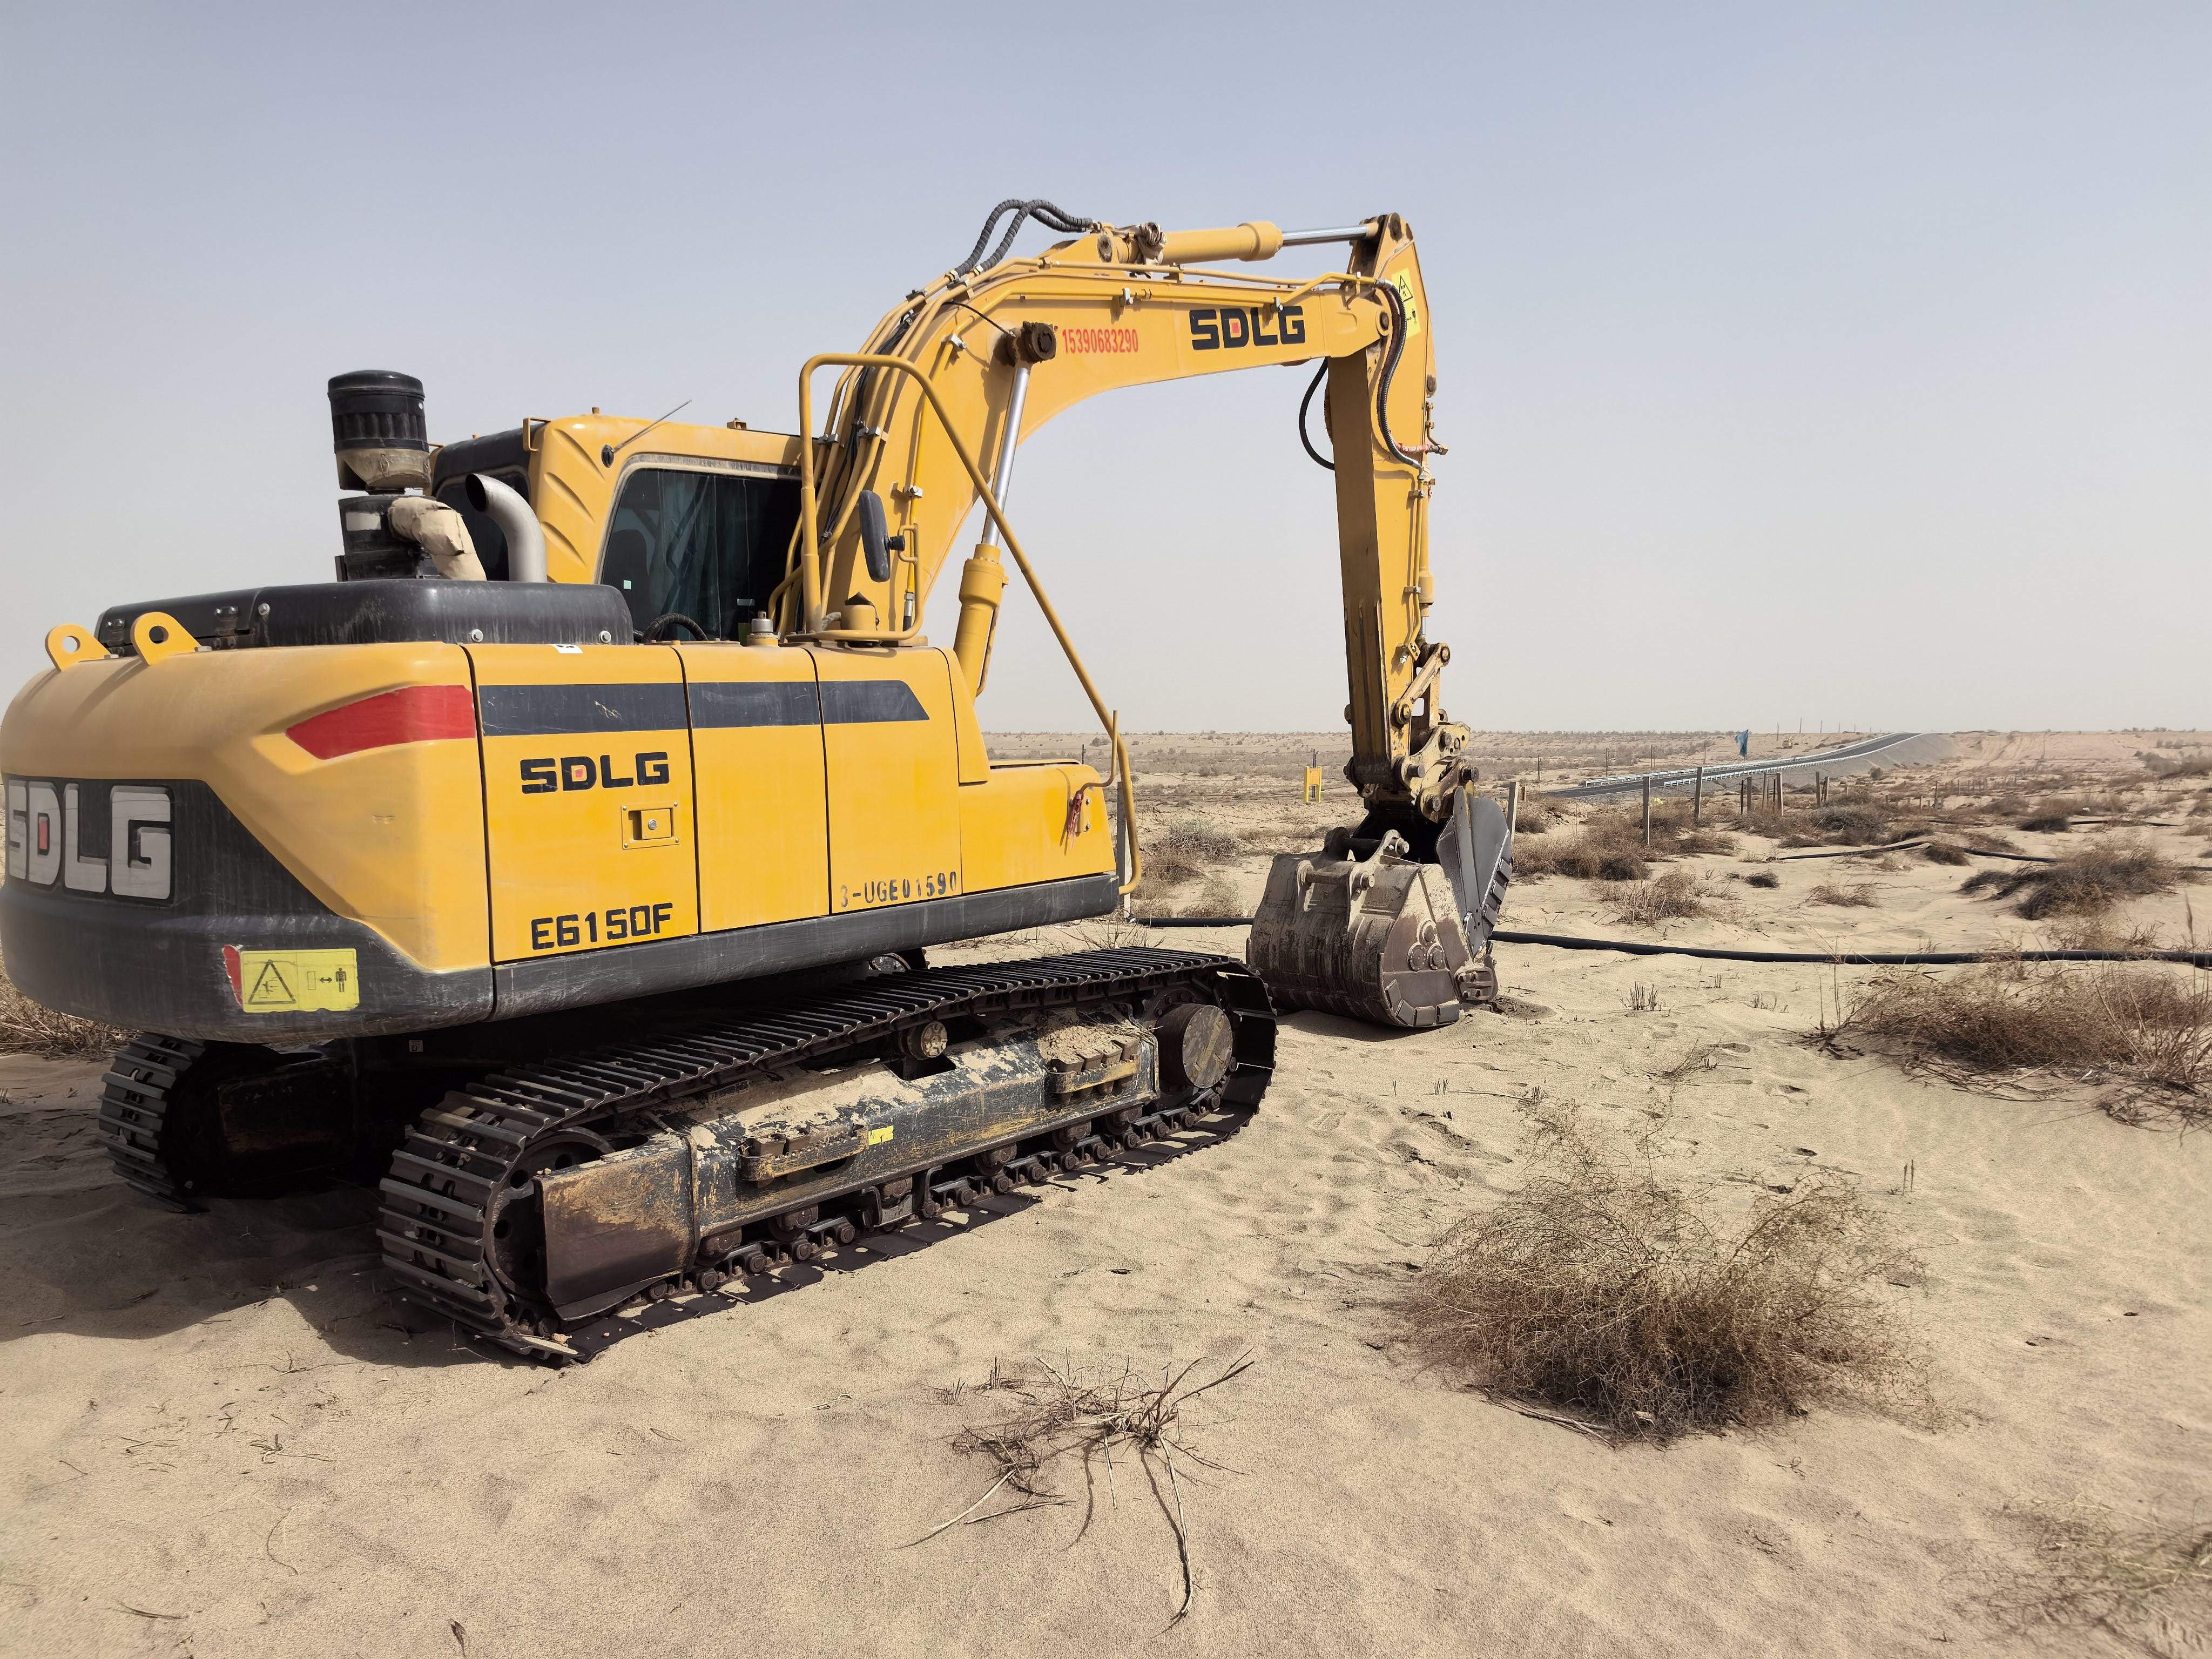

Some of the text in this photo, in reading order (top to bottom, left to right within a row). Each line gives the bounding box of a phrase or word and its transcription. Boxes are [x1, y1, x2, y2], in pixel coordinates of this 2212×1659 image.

[1062, 328, 1139, 354] 15390683290
[1189, 306, 1306, 350] SDLG
[520, 751, 670, 794] SDLG
[8, 779, 171, 900] SDLG
[531, 902, 673, 950] E6150F
